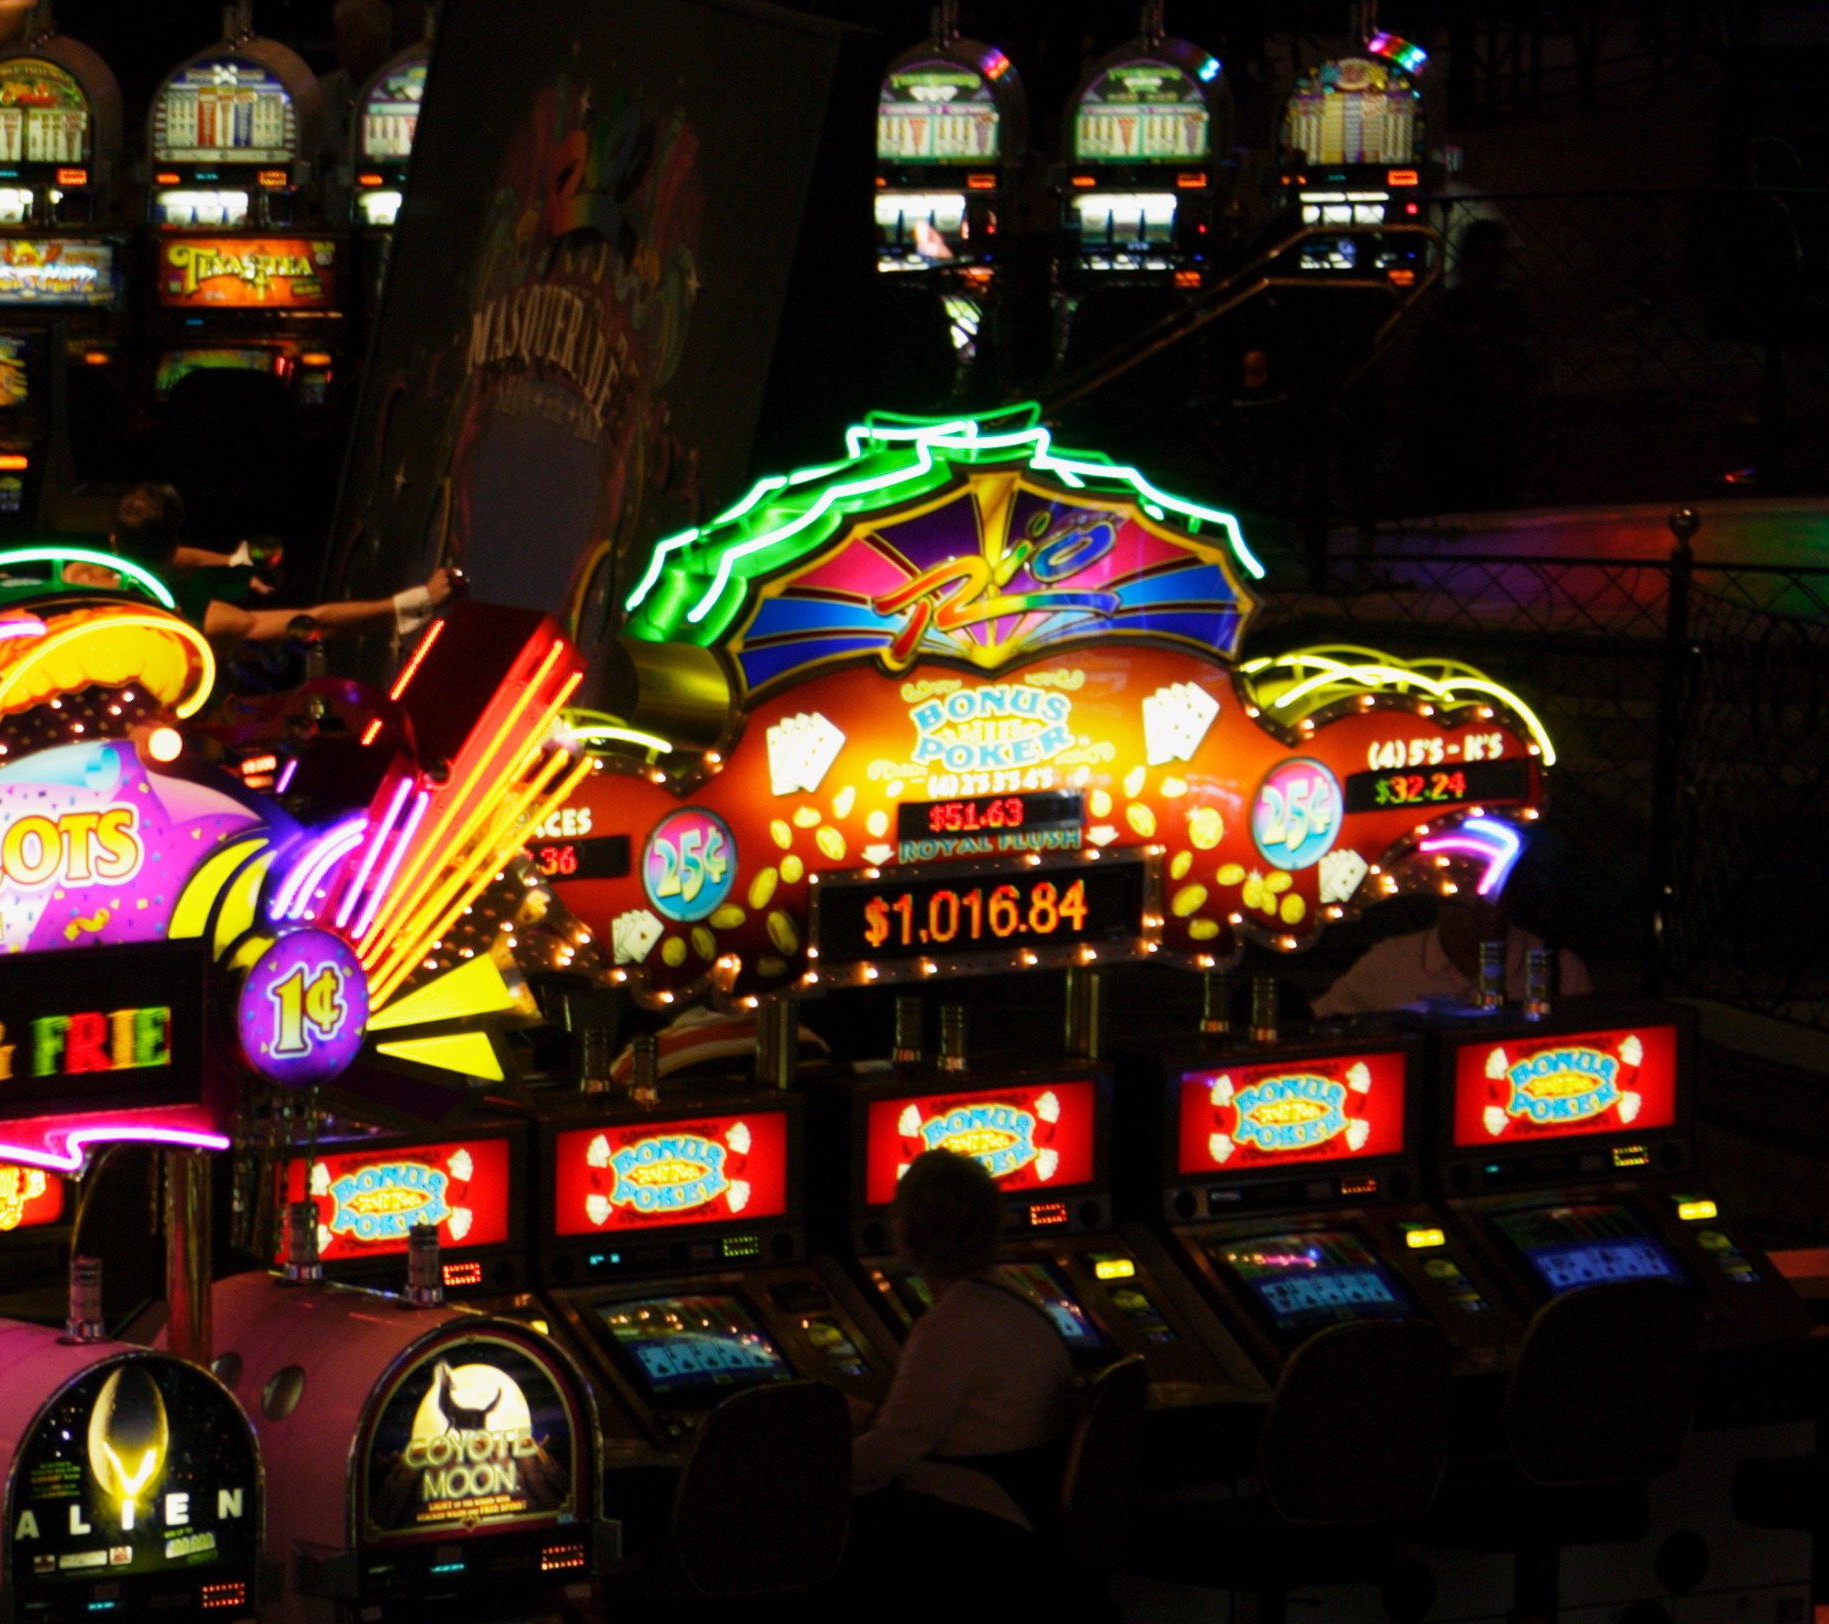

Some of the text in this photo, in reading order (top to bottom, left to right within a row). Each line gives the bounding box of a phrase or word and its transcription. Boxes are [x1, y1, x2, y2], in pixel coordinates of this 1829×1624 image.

[167, 243, 254, 295] TEXAS
[910, 685, 1072, 735] BONUS
[911, 722, 1077, 772] POKER
[1374, 770, 1466, 805] $32.24
[929, 797, 1025, 832] $51.63
[1260, 776, 1333, 851] 25¢
[653, 825, 728, 903] 25¢
[899, 828, 1082, 864] ROYAL FLUSH
[864, 878, 1089, 948] $1,016.84
[267, 960, 348, 1059] 1¢
[32, 1006, 173, 1078] FRIE
[1507, 1046, 1619, 1088] BONUS
[1232, 1074, 1347, 1114] BONUS
[1507, 1080, 1623, 1123] POKER
[919, 1104, 1038, 1151] BONUS
[1233, 1107, 1351, 1151] POKER
[609, 1134, 728, 1176] BONUS
[329, 1162, 449, 1203] BONUS
[609, 1171, 731, 1213] POKER
[329, 1198, 454, 1241] POKER
[404, 1427, 540, 1469] COYOTE
